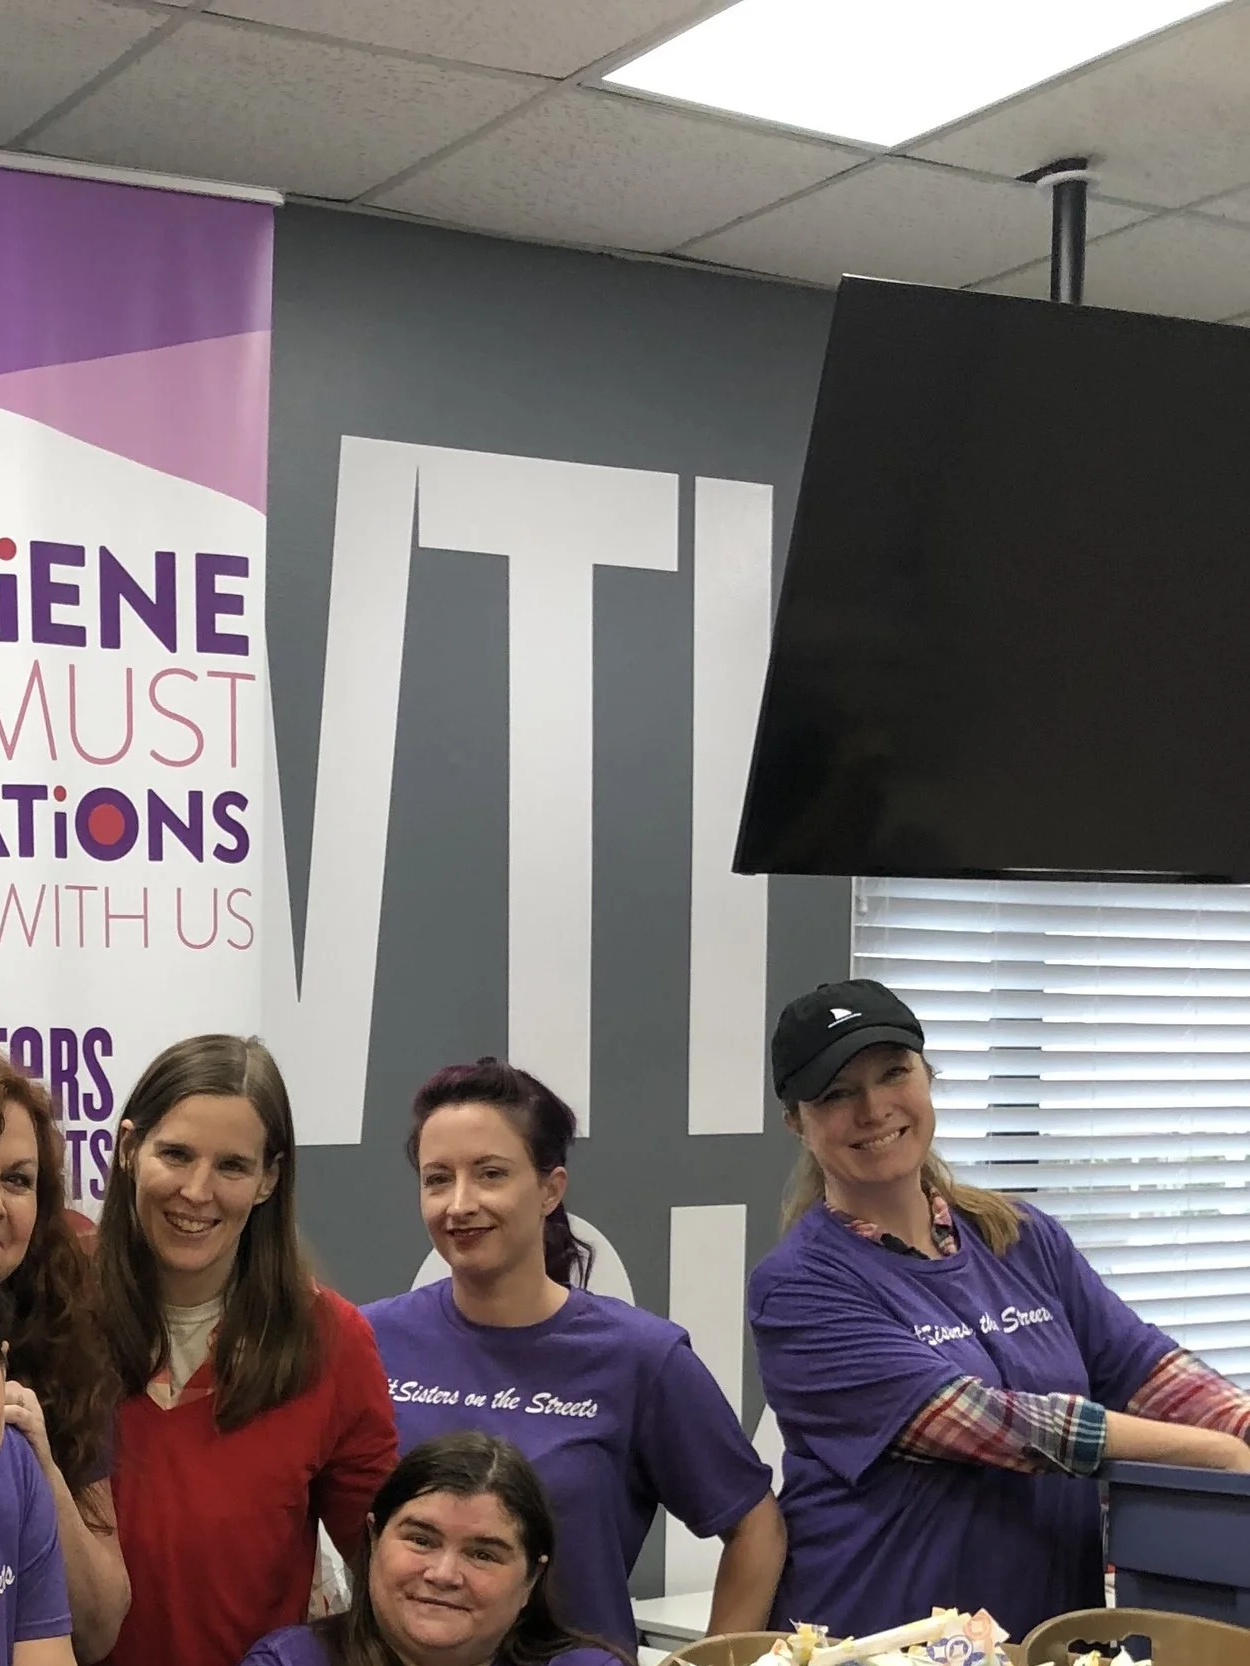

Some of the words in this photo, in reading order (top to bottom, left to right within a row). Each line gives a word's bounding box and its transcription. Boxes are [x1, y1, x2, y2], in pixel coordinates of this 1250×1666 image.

[175, 887, 254, 950] US
[464, 1391, 488, 1408] on
[491, 1387, 520, 1411] the
[525, 1391, 599, 1419] Streets
